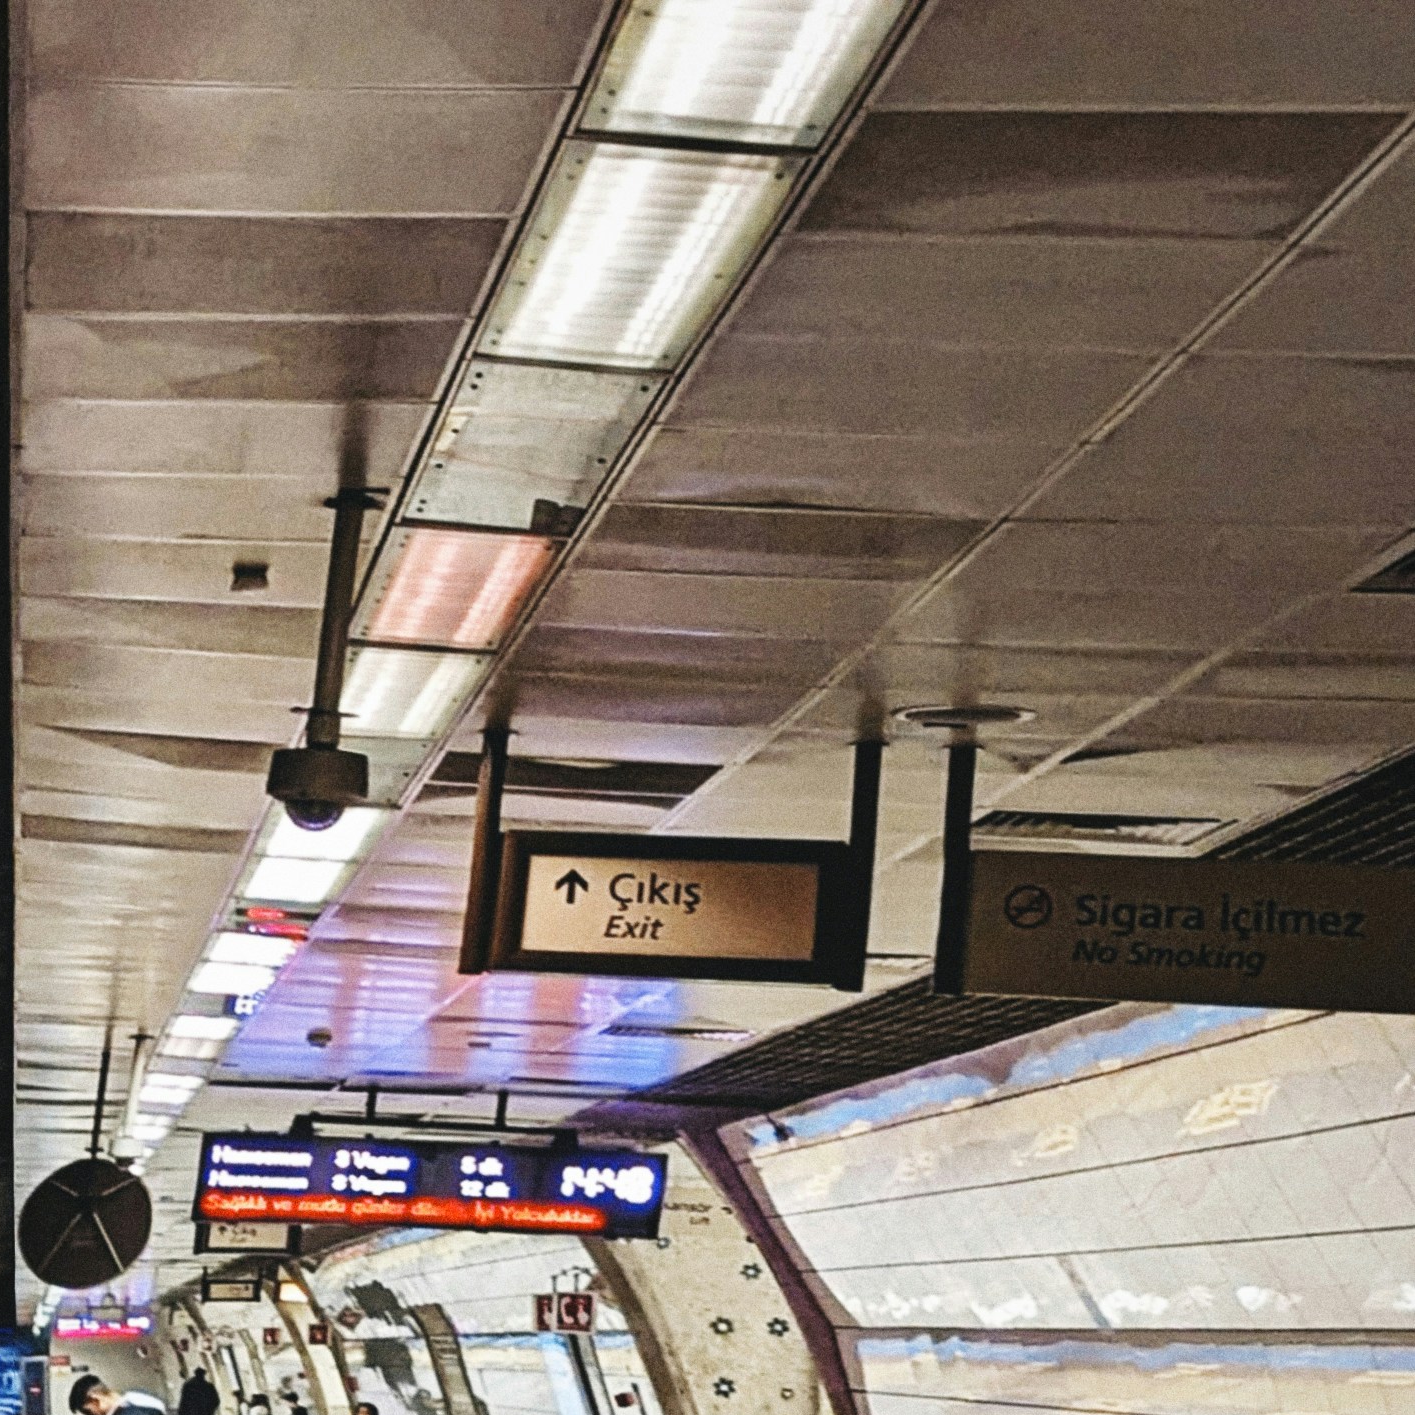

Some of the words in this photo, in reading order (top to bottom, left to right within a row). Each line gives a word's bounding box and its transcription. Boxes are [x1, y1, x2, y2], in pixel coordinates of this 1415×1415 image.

[608, 872, 703, 914] Çıkış
[603, 915, 665, 940] Exit
[1074, 894, 1205, 936] Sigara
[1220, 892, 1365, 941] İçilmez
[1071, 938, 1118, 964] No
[1127, 940, 1267, 977] Smoking
